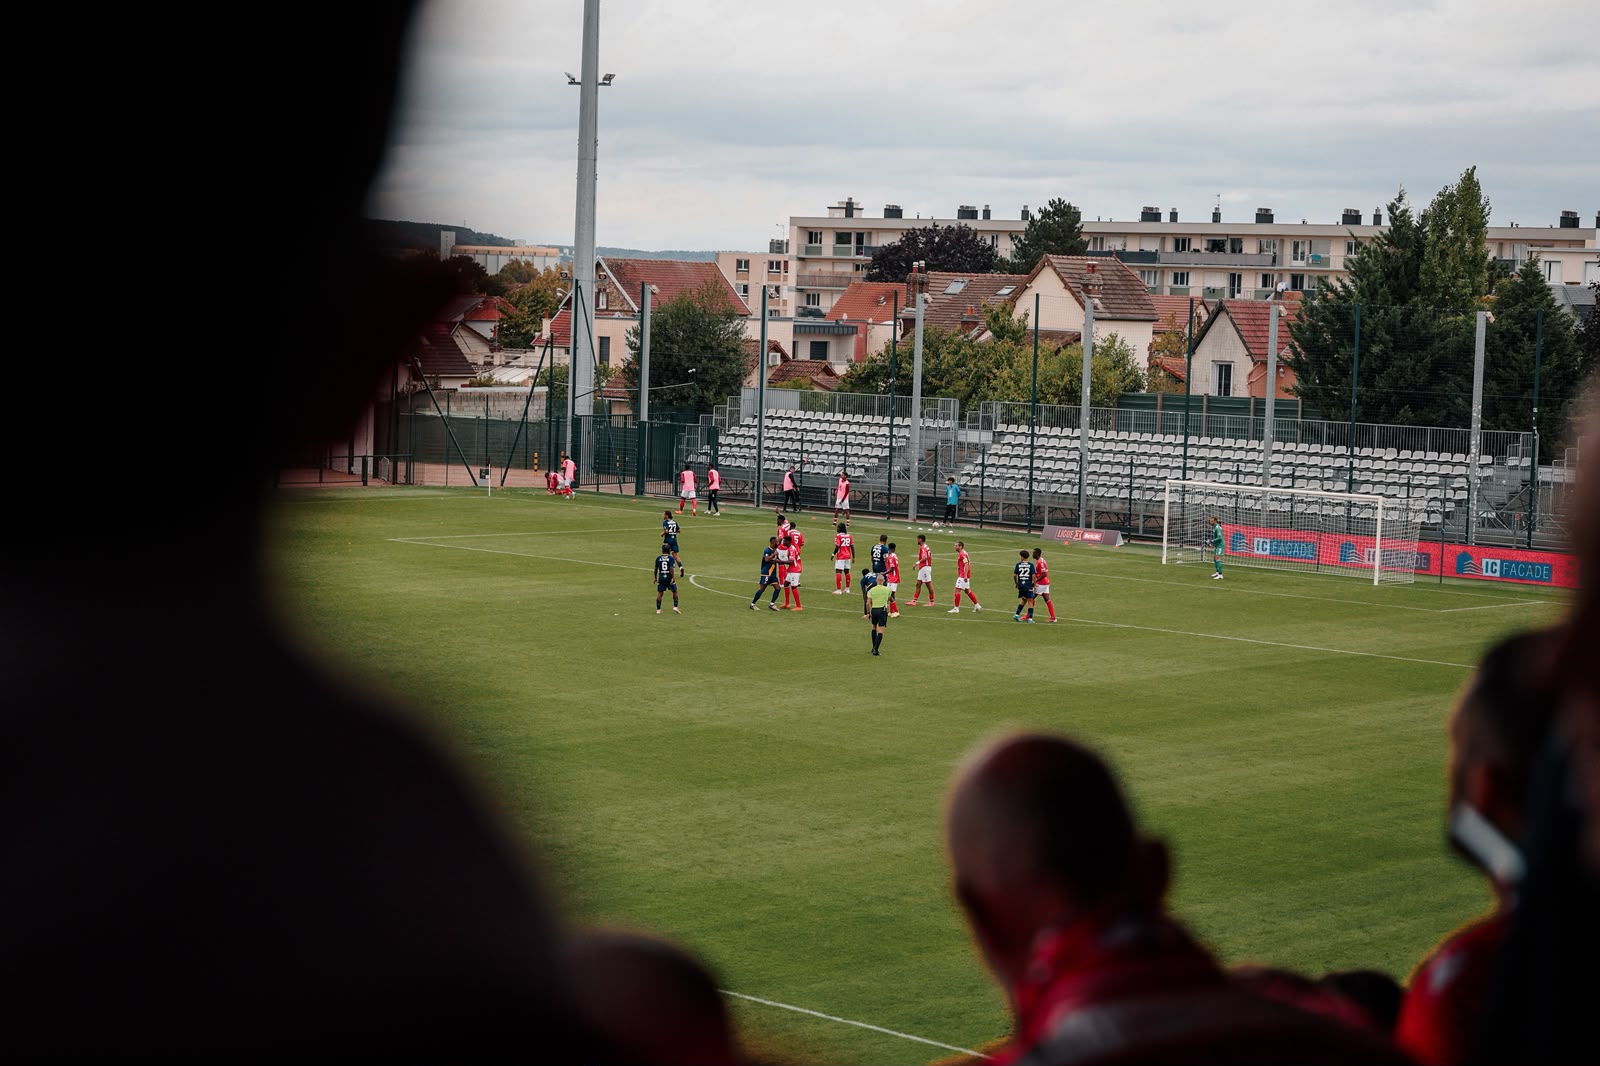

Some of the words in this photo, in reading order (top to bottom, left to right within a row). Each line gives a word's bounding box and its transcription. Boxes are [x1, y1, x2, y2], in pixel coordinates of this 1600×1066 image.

[668, 524, 677, 533] 27
[661, 561, 668, 571] 6
[1485, 560, 1498, 574] IC
[1503, 562, 1549, 579] FACADE
[1018, 567, 1030, 577] 22
